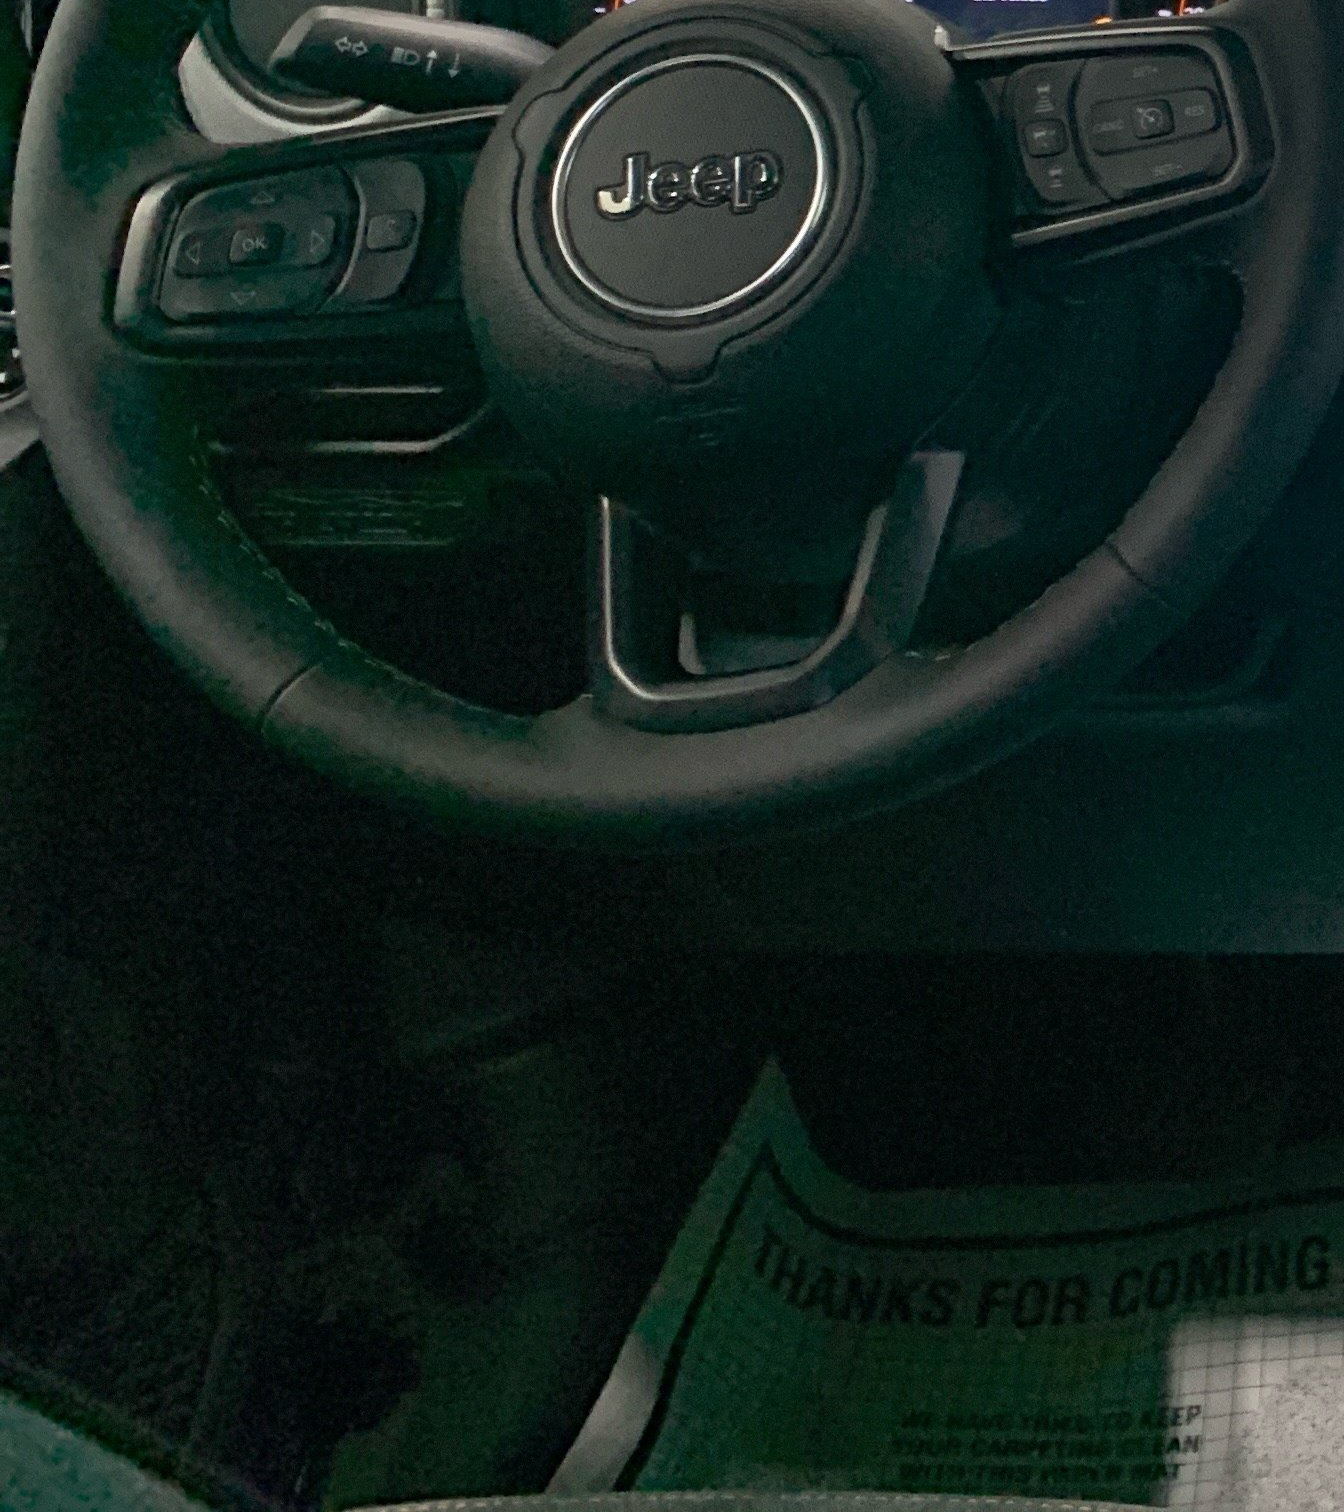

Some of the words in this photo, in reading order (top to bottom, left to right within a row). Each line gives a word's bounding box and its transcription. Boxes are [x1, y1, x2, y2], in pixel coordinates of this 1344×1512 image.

[596, 151, 782, 220] Jeep
[242, 237, 266, 252] OK
[755, 1224, 958, 1327] THANKS
[974, 1273, 1090, 1330] FOR
[1109, 1234, 1331, 1319] COMING
[1139, 1405, 1202, 1429] KEEP
[1118, 1435, 1202, 1457] CLEAN
